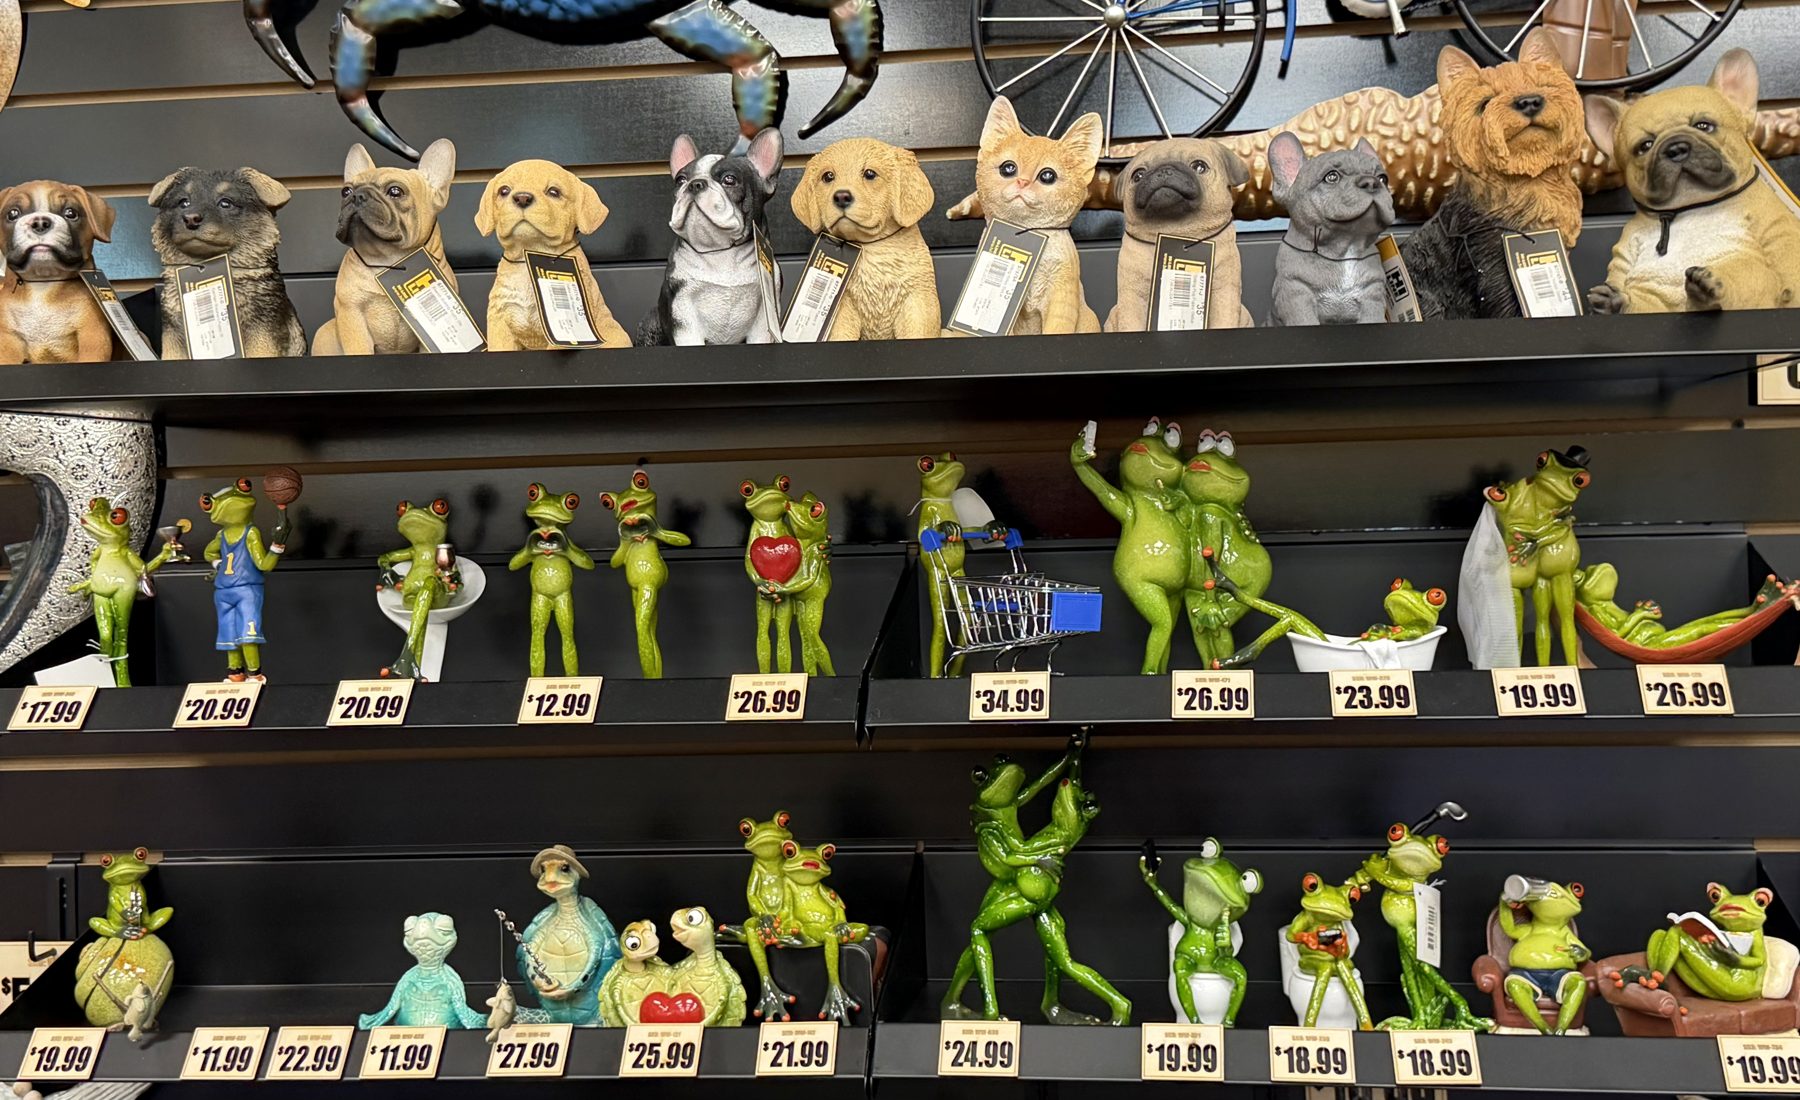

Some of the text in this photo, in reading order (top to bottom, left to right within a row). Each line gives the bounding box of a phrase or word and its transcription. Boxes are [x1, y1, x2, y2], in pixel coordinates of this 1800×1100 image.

[224, 552, 235, 575] 1
[246, 621, 257, 635] 1
[337, 695, 404, 719] $20.99
[527, 693, 592, 717] $12.99
[733, 689, 801, 714] $26.99
[975, 688, 1045, 714] $34.99
[1176, 687, 1249, 711] $26.99
[1335, 684, 1411, 710] $23.99
[1499, 683, 1577, 709] $19.99
[1645, 681, 1727, 707] $26.99
[21, 700, 82, 723] $17.99
[185, 697, 251, 721] $20.99
[30, 1046, 93, 1072] $19.99
[192, 1046, 254, 1072] $11.99
[277, 1045, 342, 1072] $22.99
[370, 1044, 433, 1071] $11.99
[496, 1042, 560, 1069] $27.99
[628, 1041, 696, 1069] $25.99
[762, 1040, 829, 1068] $21.99
[944, 1040, 1014, 1069] $24.99
[1146, 1042, 1217, 1073] $19.99
[1274, 1046, 1348, 1075] $18.99
[1397, 1049, 1473, 1076] $18.99
